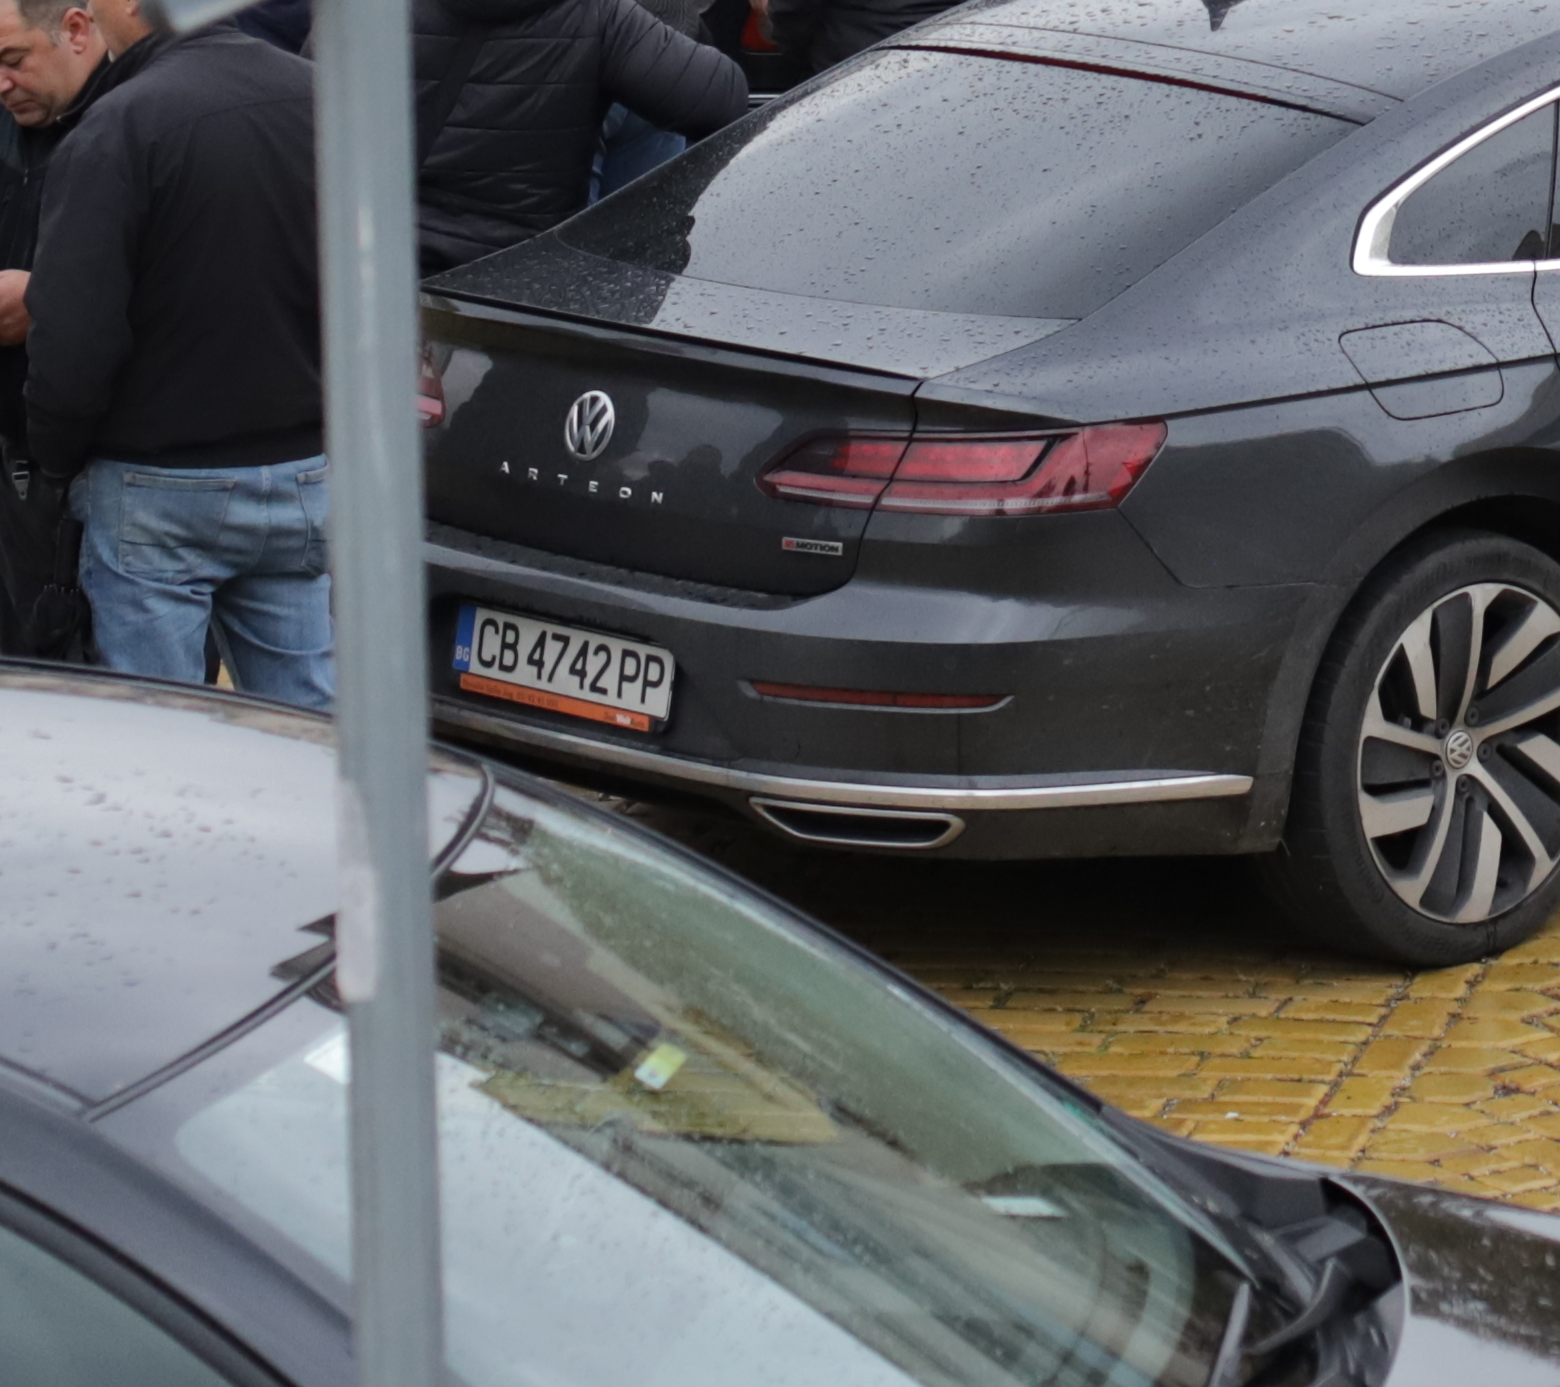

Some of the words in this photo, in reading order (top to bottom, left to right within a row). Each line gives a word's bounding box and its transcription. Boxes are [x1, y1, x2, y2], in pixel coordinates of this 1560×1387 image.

[499, 461, 664, 505] ARTEON
[455, 645, 470, 662] BG
[477, 617, 520, 673] CB
[527, 629, 612, 697] 4742
[616, 647, 666, 705] PP
